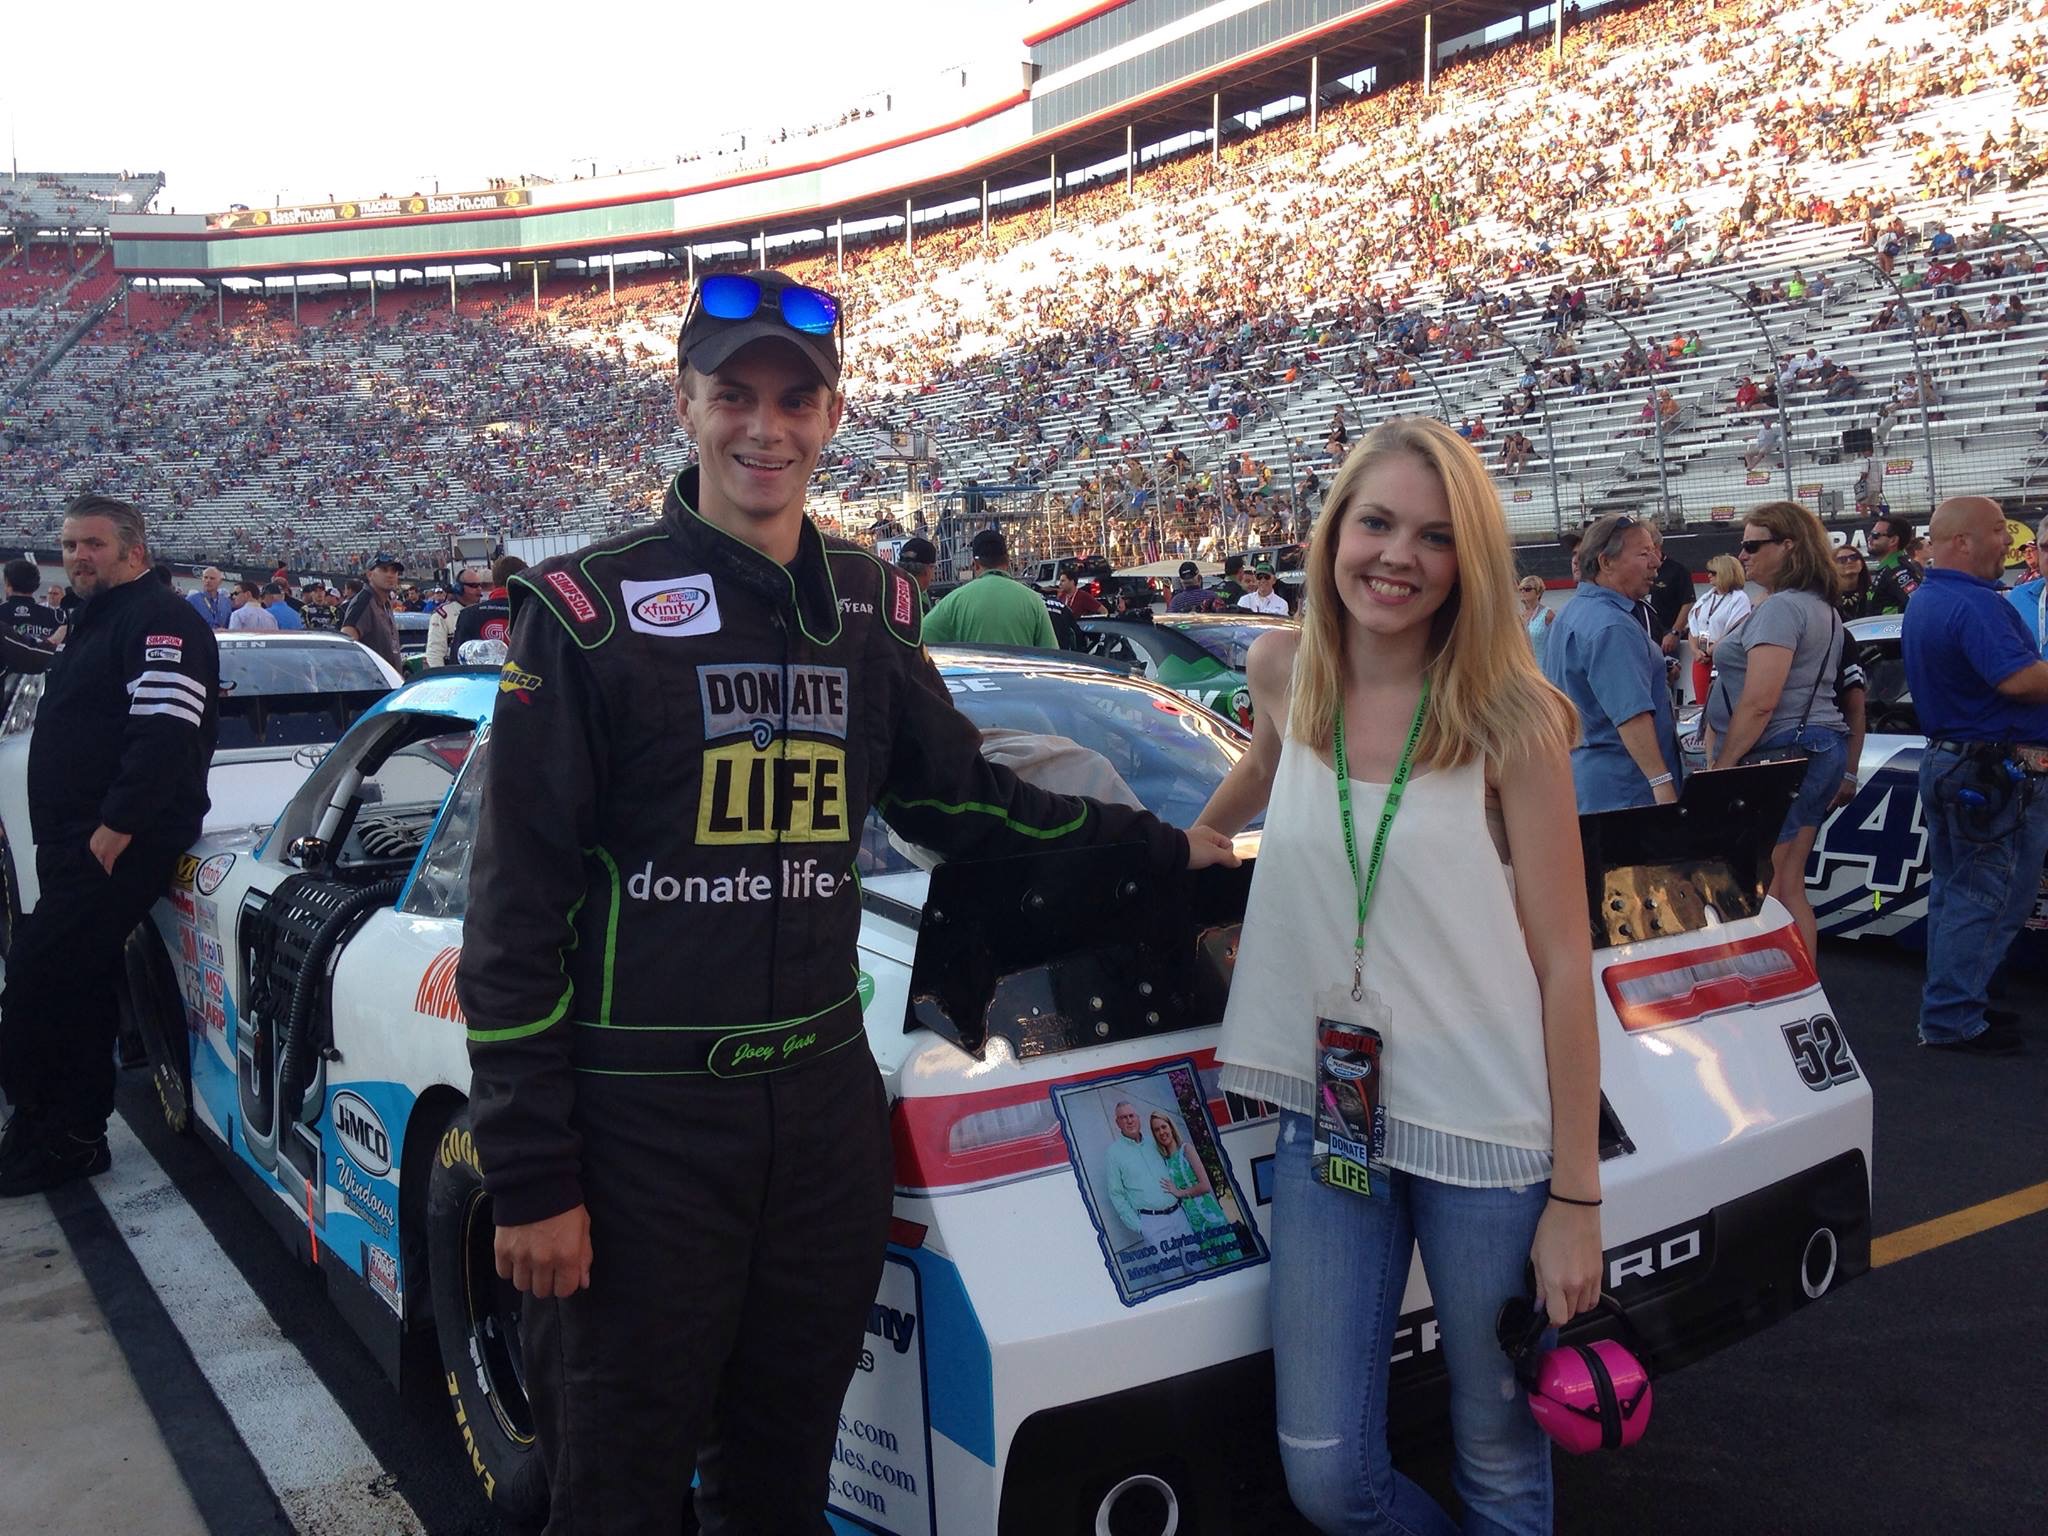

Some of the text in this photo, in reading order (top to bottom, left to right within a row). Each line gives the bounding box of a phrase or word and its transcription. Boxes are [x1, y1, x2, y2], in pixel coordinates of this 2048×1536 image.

[270, 207, 336, 225] BassPro.com
[428, 194, 497, 212] BassPro.com
[551, 572, 595, 621] SIMPSON
[643, 601, 695, 618] xfinity
[896, 577, 911, 624] SIMPSON
[706, 671, 844, 716] DONATE
[709, 758, 842, 832] LIFE
[627, 858, 835, 903] donate life
[204, 967, 224, 998] MSD
[205, 1001, 227, 1033] ARP
[731, 1042, 776, 1066] Joey
[1780, 1012, 1860, 1093] 52
[1331, 1136, 1366, 1161] DONATE
[335, 1155, 395, 1227] Windows
[1332, 1160, 1369, 1193] LIFE
